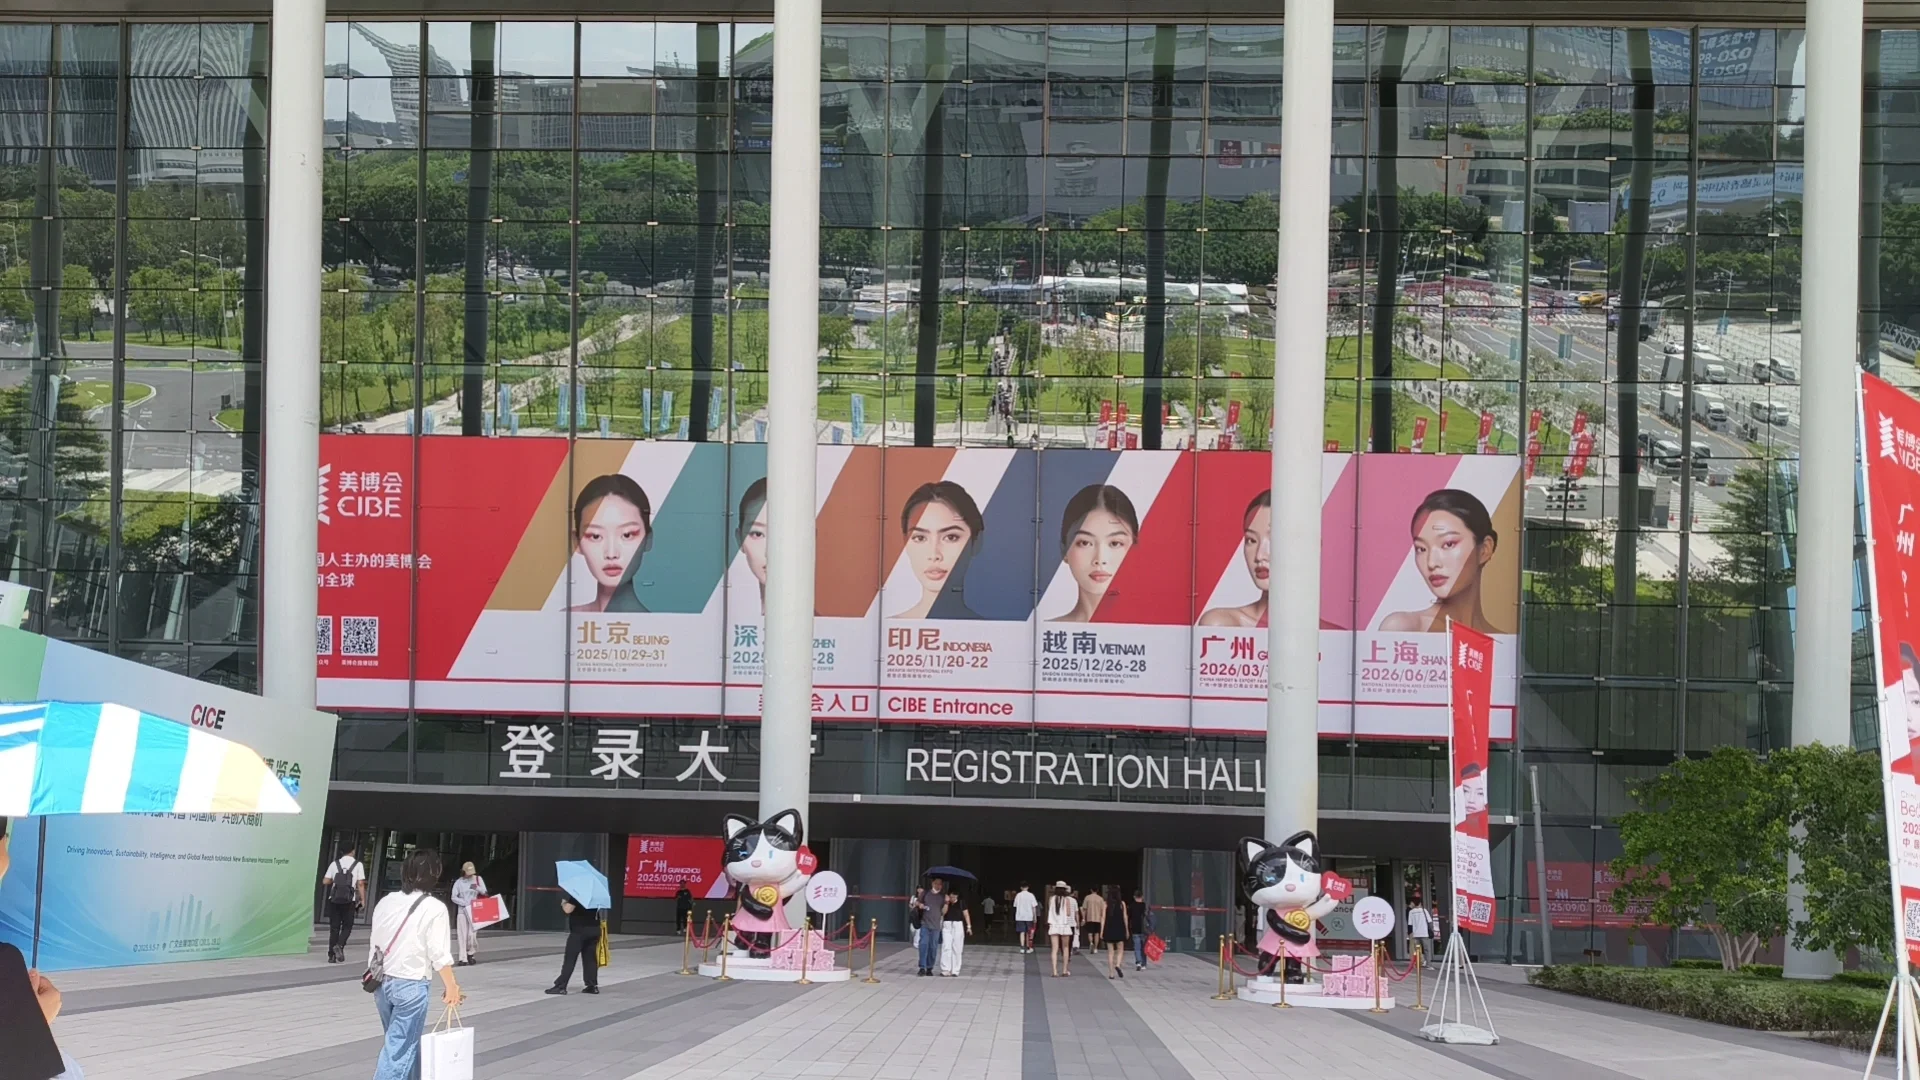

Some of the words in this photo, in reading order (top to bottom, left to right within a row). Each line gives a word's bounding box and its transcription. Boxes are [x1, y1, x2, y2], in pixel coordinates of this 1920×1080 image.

[338, 471, 402, 493] 美博会
[337, 496, 402, 517] CIBE
[577, 621, 631, 645] 北京
[733, 624, 765, 648] 深
[888, 628, 940, 650] 印尼
[943, 642, 993, 652] INDONESIA
[1042, 631, 1097, 654] 越南
[1099, 643, 1146, 655] VIETNAM
[576, 648, 666, 660] 2025/10/29-31
[1199, 635, 1254, 660] 广州
[1362, 640, 1419, 665] 上海
[1421, 655, 1448, 666] SHAN
[887, 654, 989, 669] 2025/11/20-22
[1042, 657, 1147, 672] 2025/12/26-28
[191, 704, 226, 730] CICE
[887, 696, 926, 713] CIBE
[933, 698, 1013, 715] Entrance
[499, 724, 817, 784] 登录大
[905, 748, 1168, 789] REGISTRATION
[1184, 755, 1266, 793] HALL
[638, 860, 667, 873] 广州
